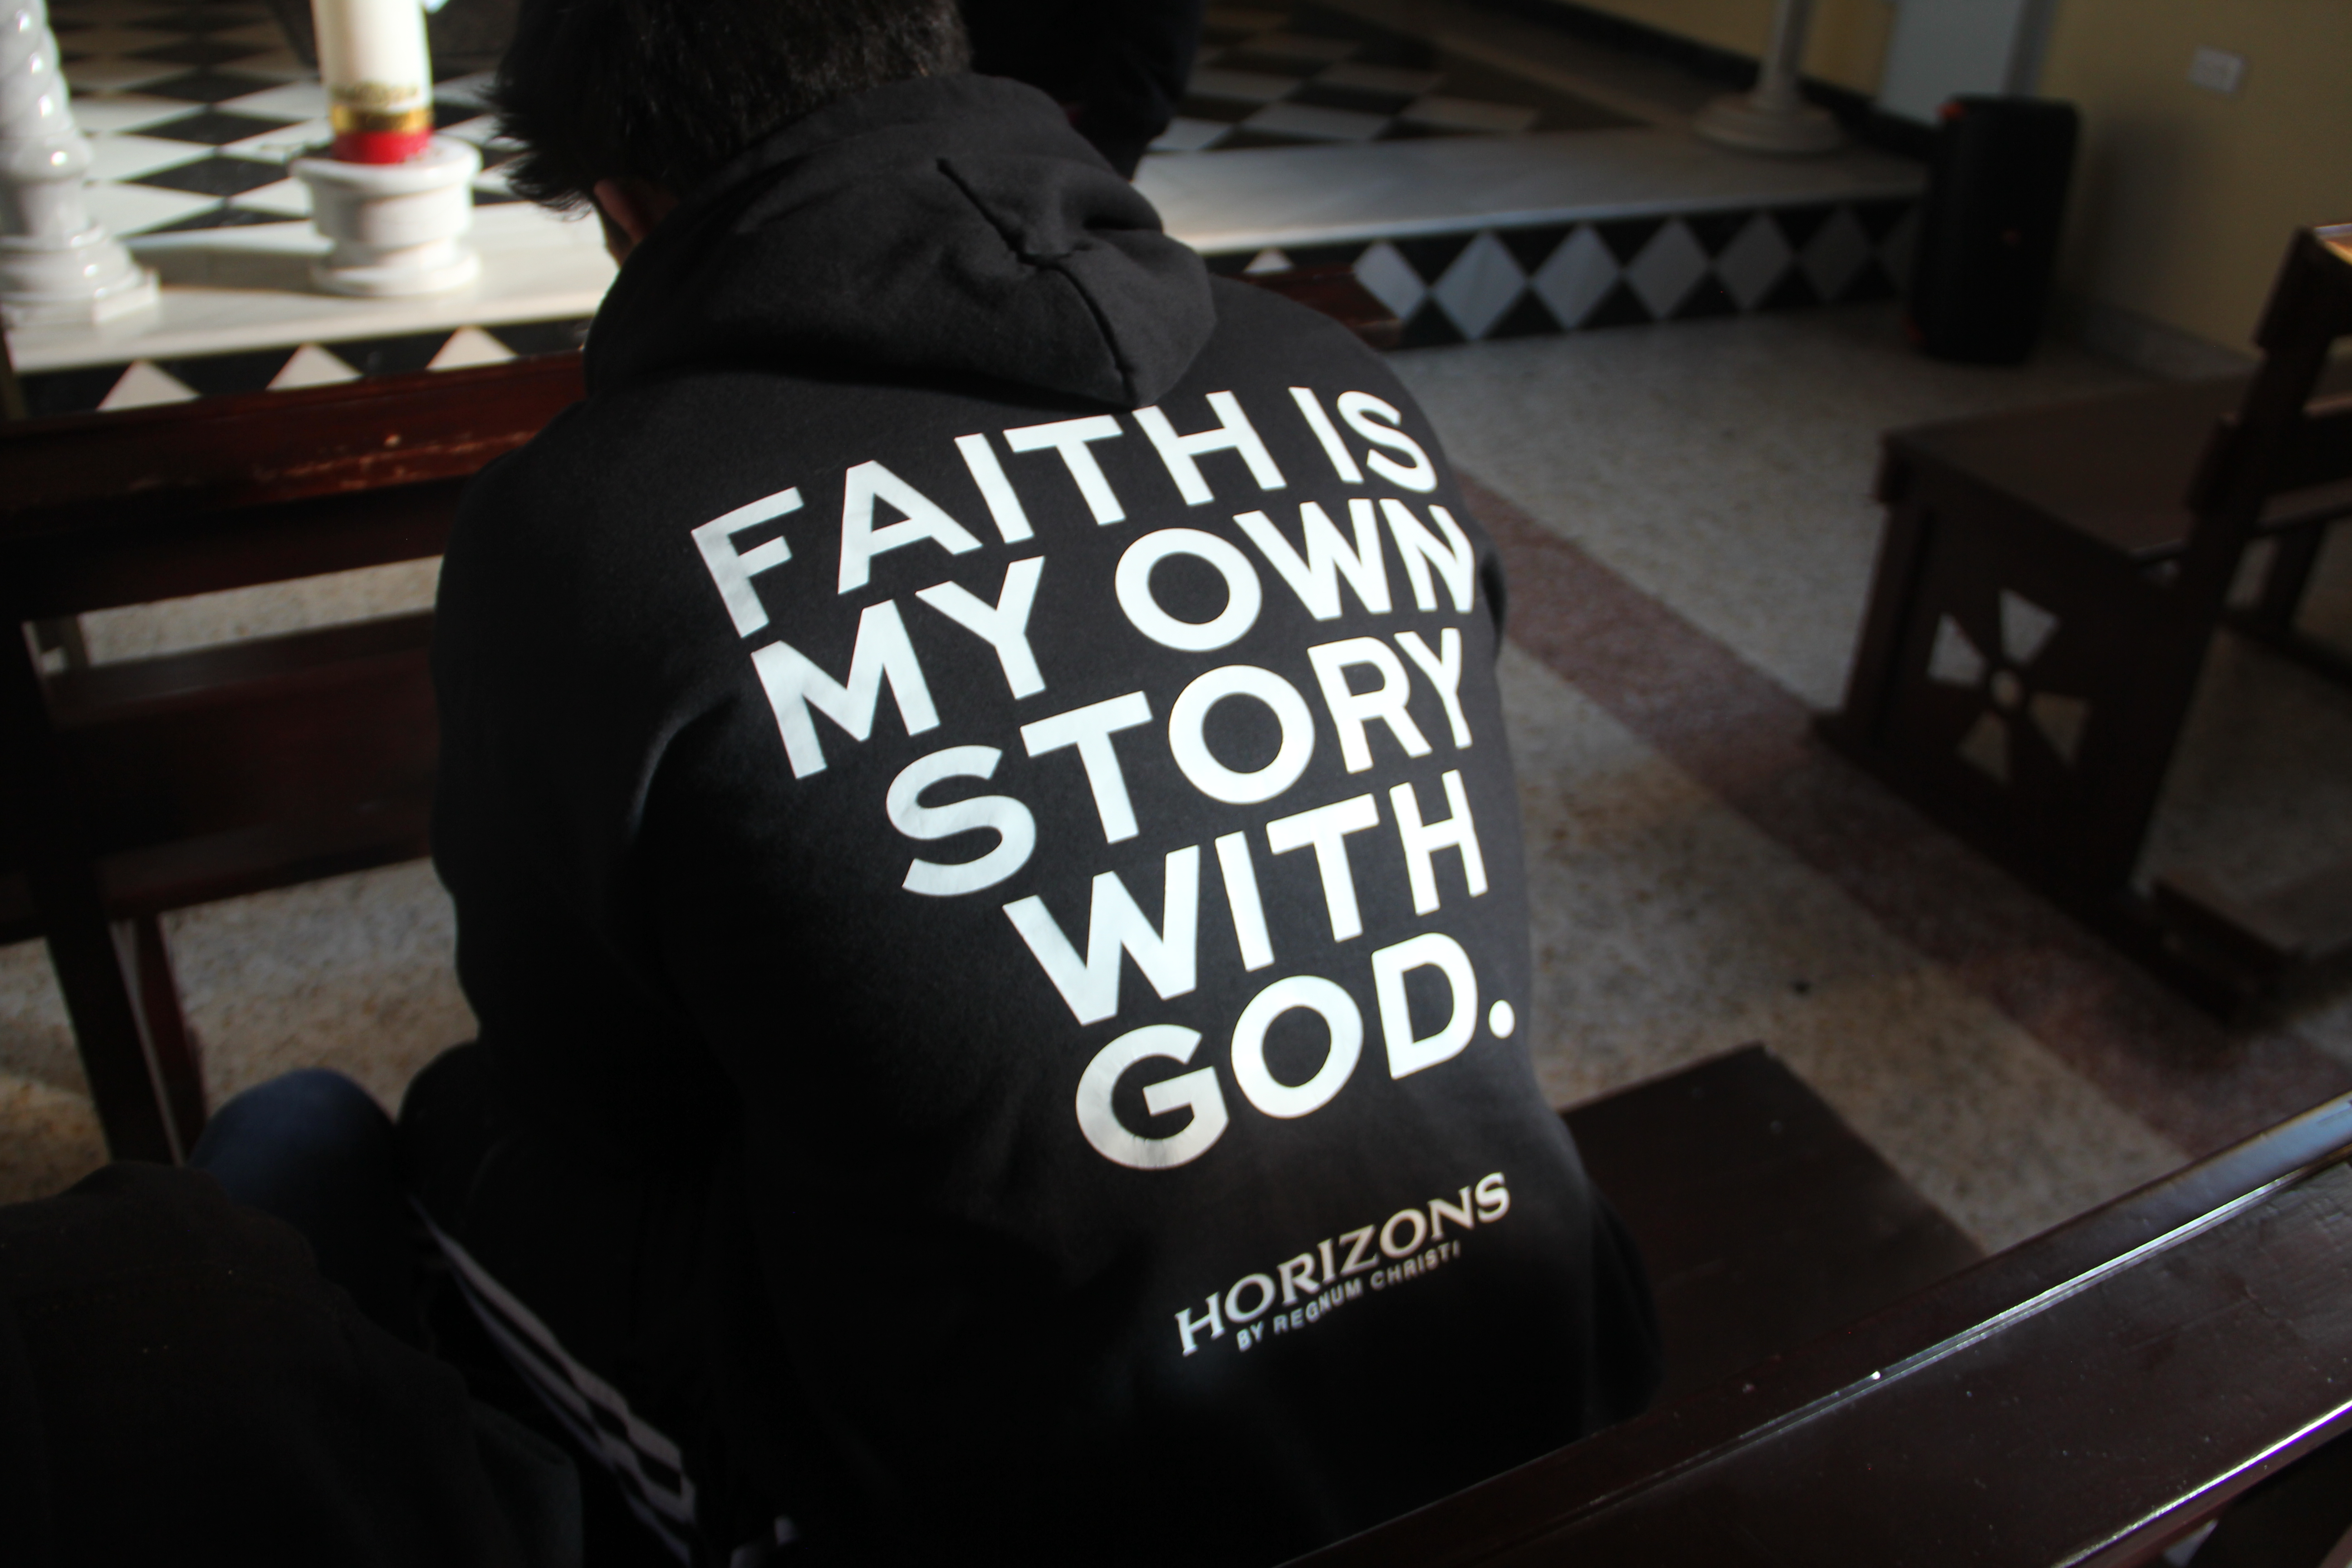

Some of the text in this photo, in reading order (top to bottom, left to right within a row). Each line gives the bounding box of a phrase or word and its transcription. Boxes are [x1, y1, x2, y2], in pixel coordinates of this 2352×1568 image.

[690, 386, 1438, 639] FAITH IS
[750, 497, 1475, 779] MY OWN
[885, 627, 1474, 897] STORY
[1002, 768, 1489, 1026] WITH
[1075, 931, 1516, 1169] GOD.
[1174, 1171, 1511, 1356] HORIZONS
[1236, 1240, 1461, 1352] BY REGNUM CHRISTI
